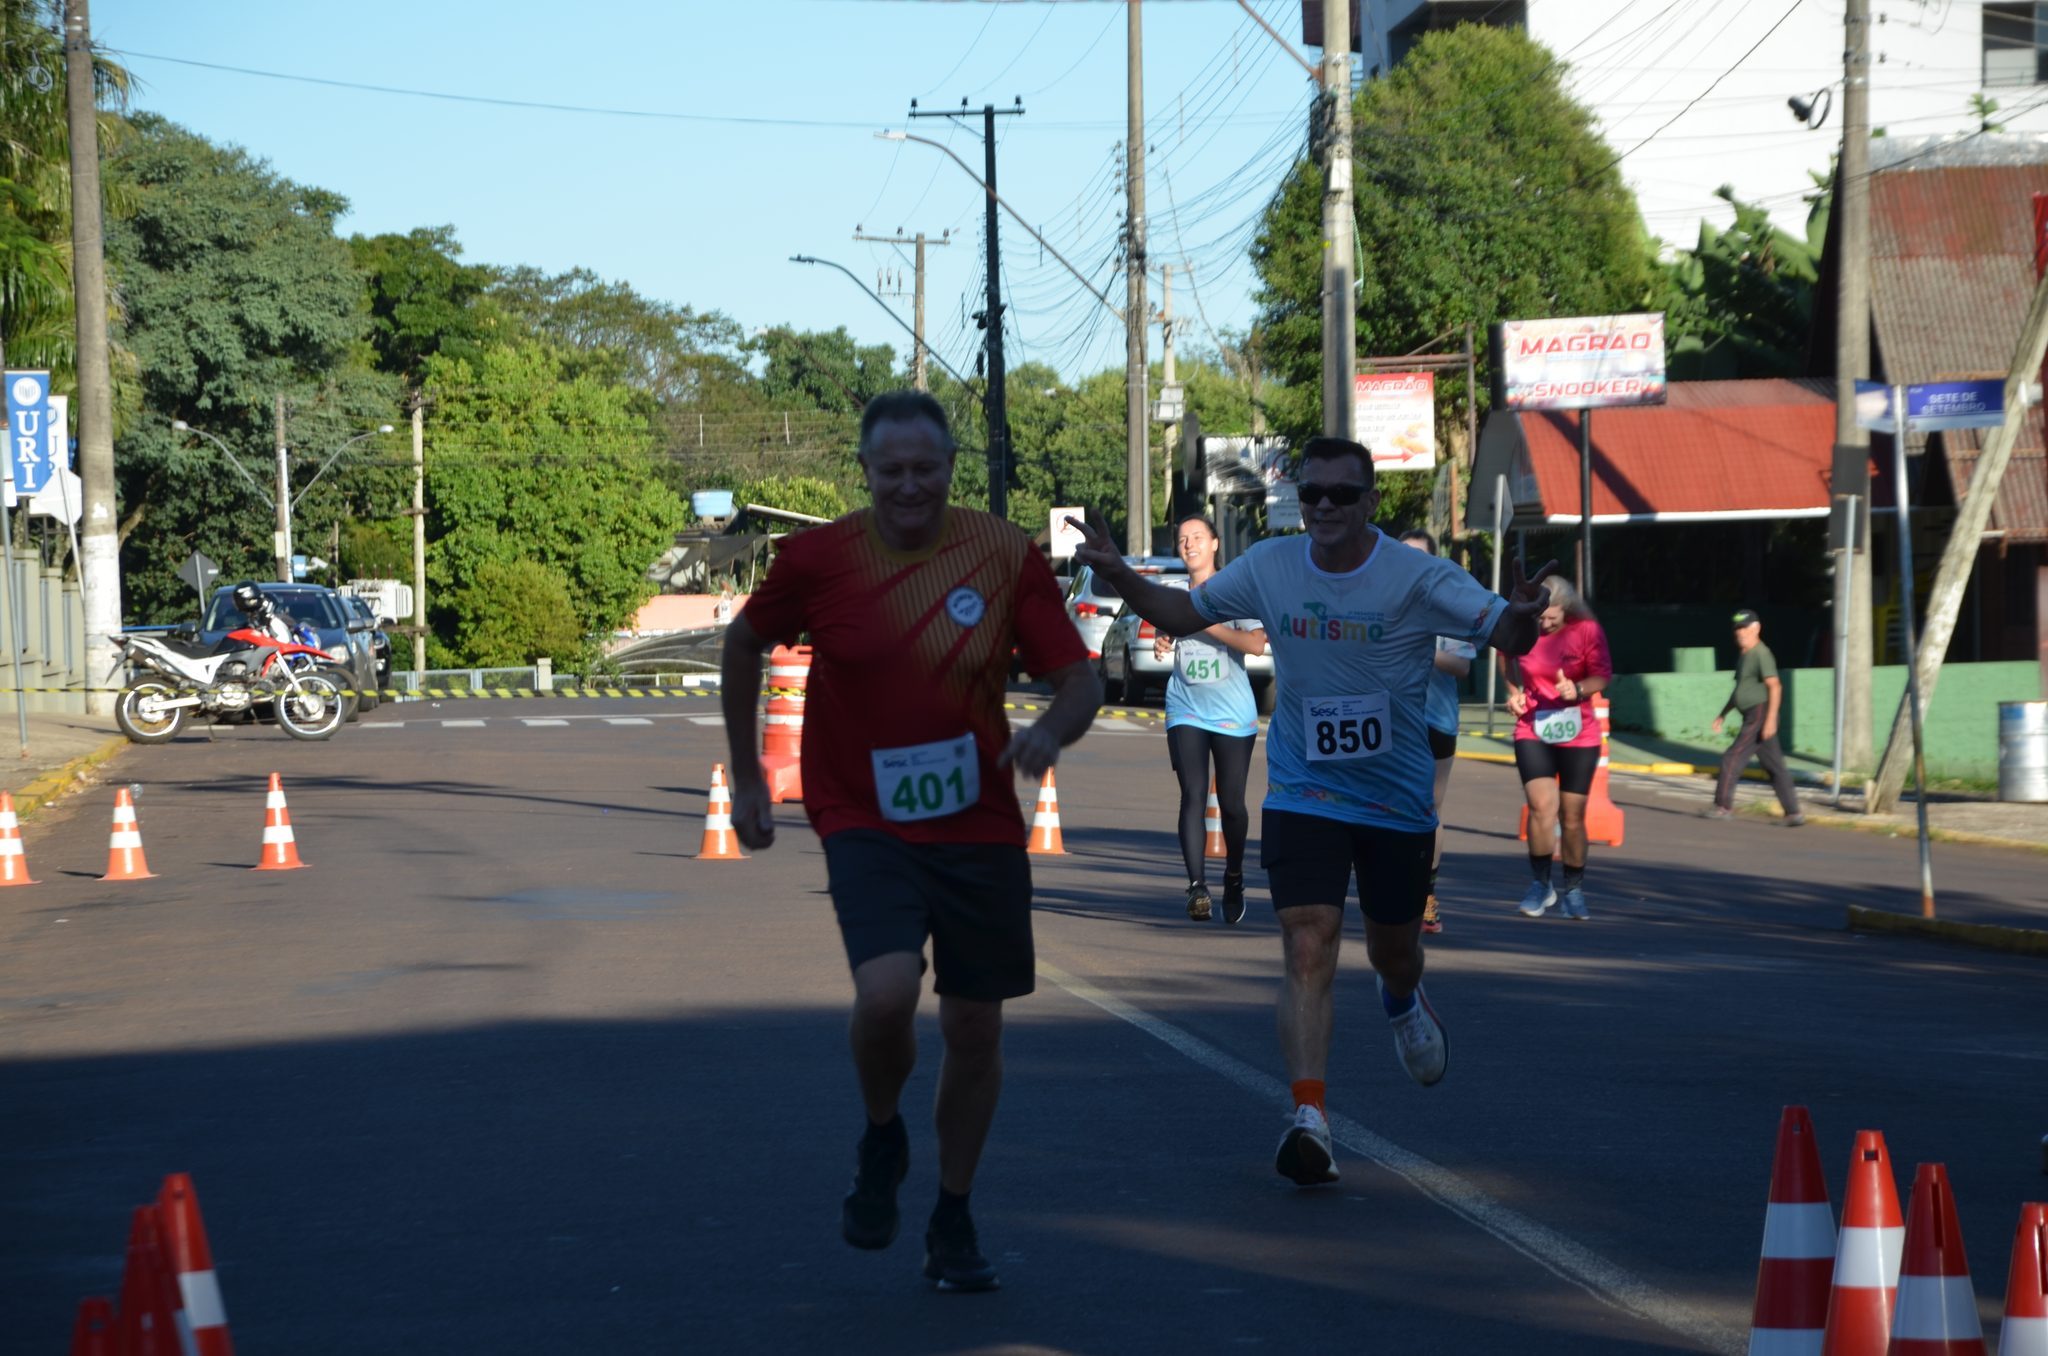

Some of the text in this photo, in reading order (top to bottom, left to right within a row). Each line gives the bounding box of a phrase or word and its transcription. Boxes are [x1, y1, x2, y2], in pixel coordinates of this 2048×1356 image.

[1519, 327, 1652, 355] MAGRÃO
[1356, 376, 1429, 393] MAGRÃO
[1534, 379, 1643, 398] SNOOKER
[1922, 401, 1985, 415] SETEMBRO
[1929, 391, 1977, 403] SETE DE
[16, 410, 41, 488] URI
[1279, 613, 1384, 642] Autismo
[1186, 658, 1221, 680] 451
[1316, 717, 1382, 756] 850
[1542, 720, 1577, 740] 439
[891, 765, 966, 814] 401
